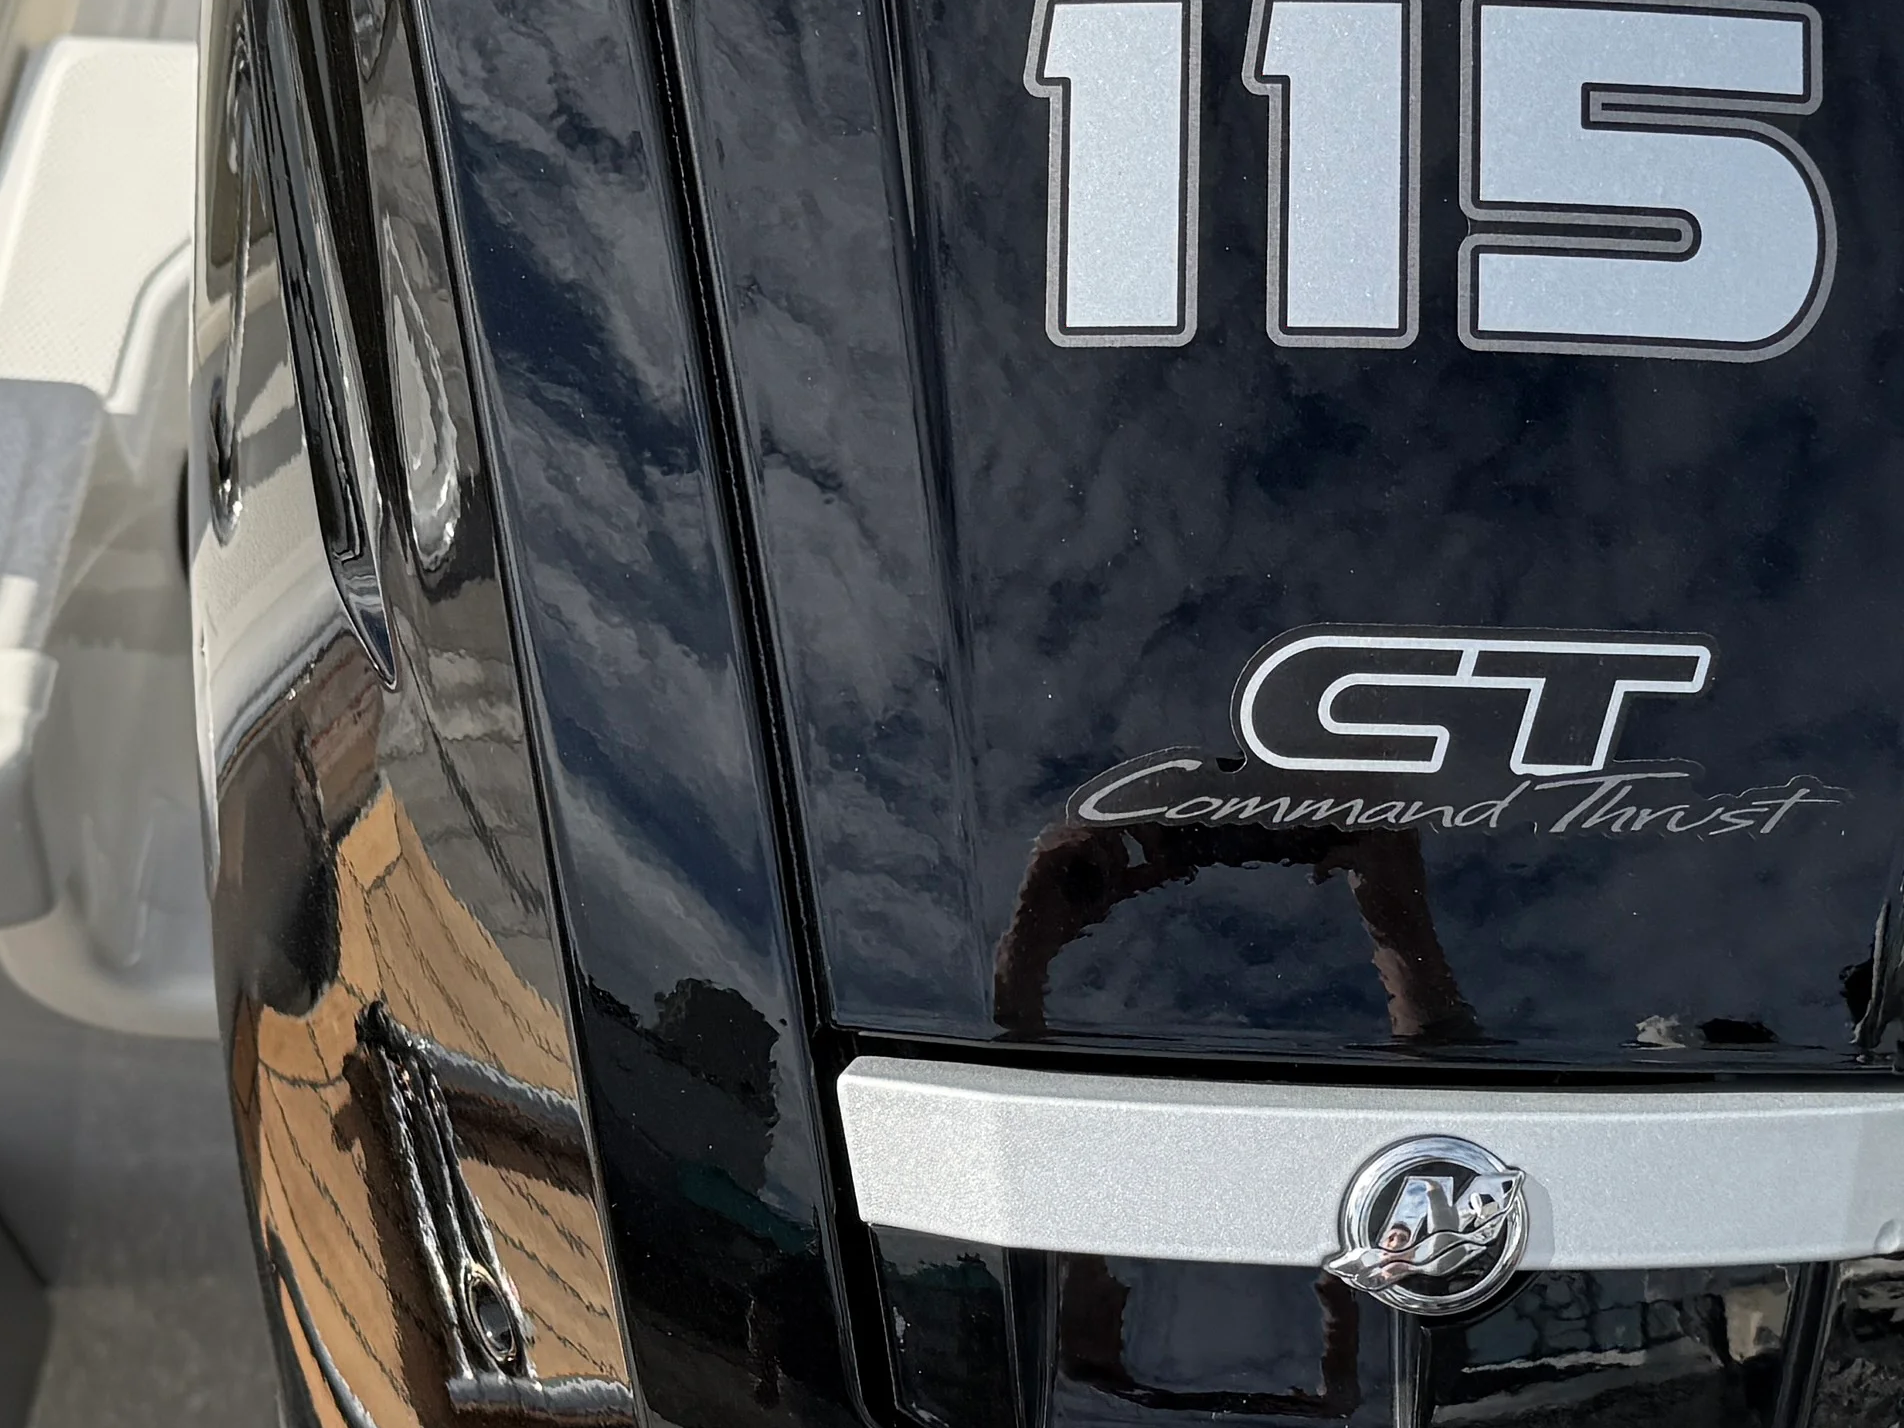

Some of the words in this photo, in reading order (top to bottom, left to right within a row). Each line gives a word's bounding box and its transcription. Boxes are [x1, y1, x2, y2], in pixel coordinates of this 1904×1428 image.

[1239, 635, 1712, 776] CT
[1078, 758, 1526, 828] Command
[1546, 772, 1842, 836] Thrust
